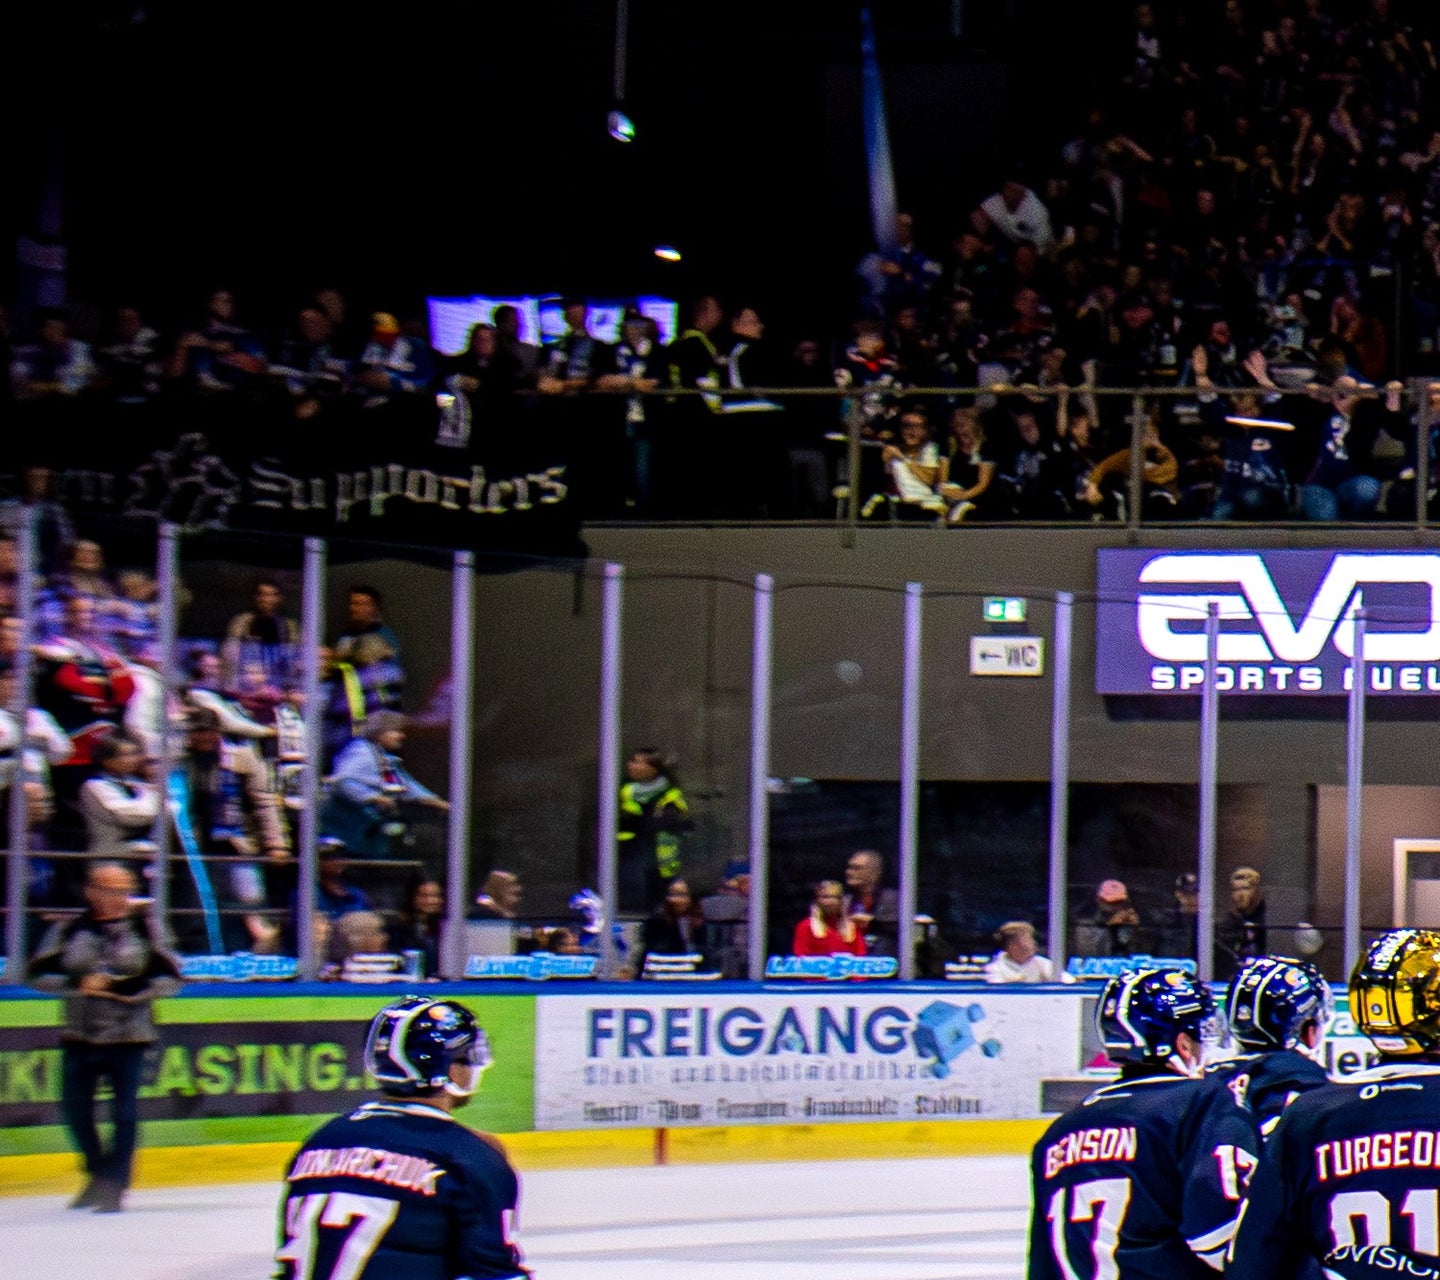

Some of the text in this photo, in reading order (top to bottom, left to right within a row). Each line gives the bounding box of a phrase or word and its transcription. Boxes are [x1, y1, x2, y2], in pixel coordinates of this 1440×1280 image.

[1150, 665, 1323, 692] SPORTS
[586, 1005, 916, 1058] FREIGANG
[1045, 1126, 1138, 1179] BENSON
